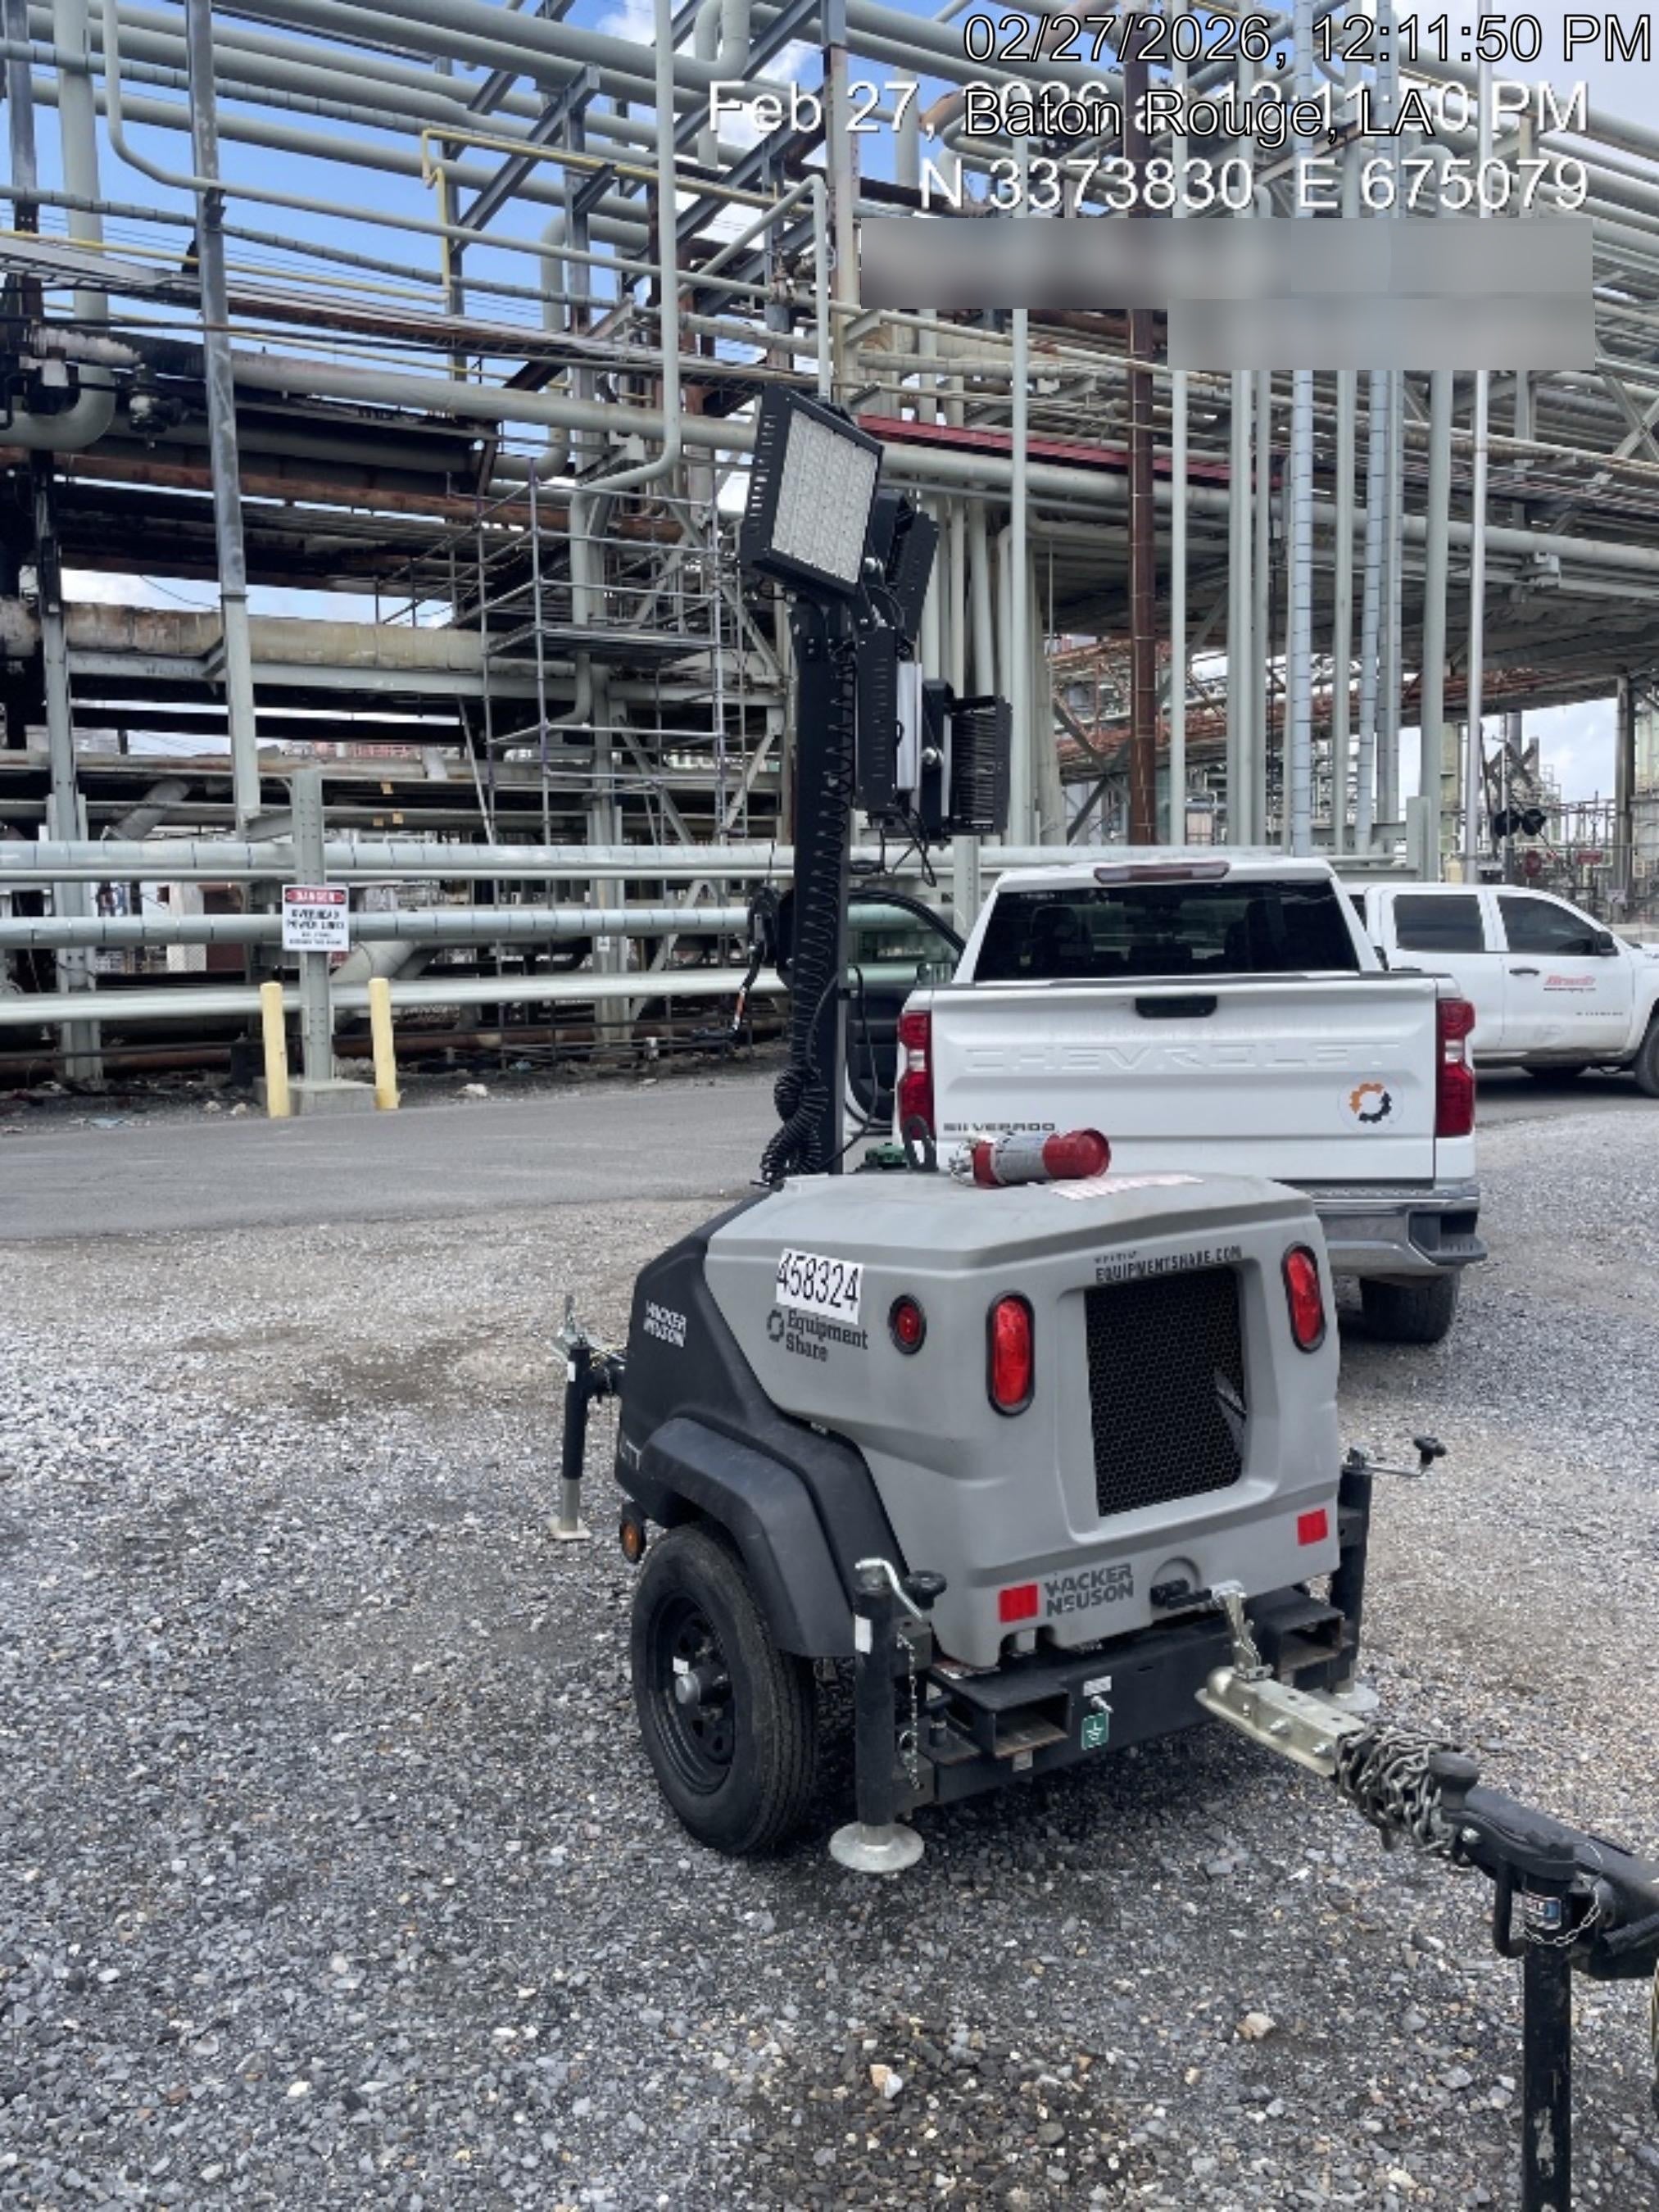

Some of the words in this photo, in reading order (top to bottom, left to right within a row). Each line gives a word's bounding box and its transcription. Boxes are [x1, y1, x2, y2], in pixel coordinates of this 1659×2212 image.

[964, 1041, 1401, 1072] CHEVROLET
[943, 1122, 1056, 1132] SILVERADO
[1095, 1244, 1243, 1283] EQUIPMENTSHARE.COM
[776, 1252, 860, 1312] 458324
[786, 1308, 869, 1351] Equipment
[786, 1331, 829, 1362] Share
[1043, 1562, 1134, 1598] WACKER
[1045, 1580, 1135, 1617] NEUSON
